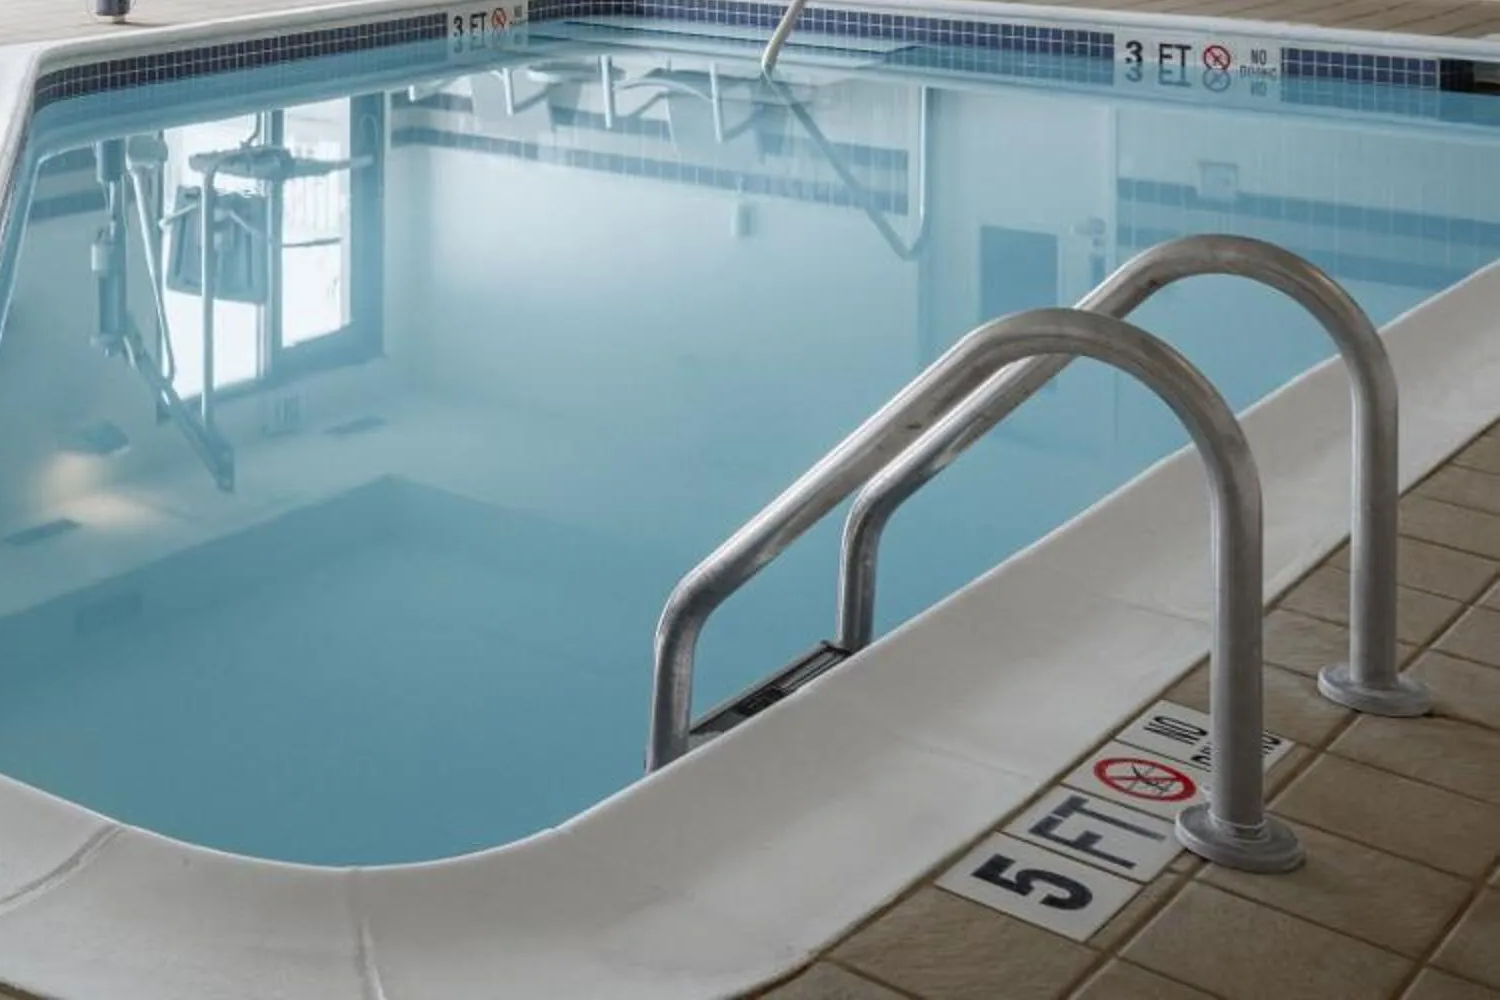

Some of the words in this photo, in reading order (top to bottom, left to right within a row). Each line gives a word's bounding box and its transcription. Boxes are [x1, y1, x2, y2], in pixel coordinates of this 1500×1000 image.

[453, 15, 463, 37] 3
[1125, 40, 1143, 65] 3
[1158, 43, 1192, 67] FT
[1251, 49, 1267, 65] NO
[1143, 715, 1208, 746] NO
[1028, 795, 1167, 870] FT
[970, 853, 1094, 911] 5
